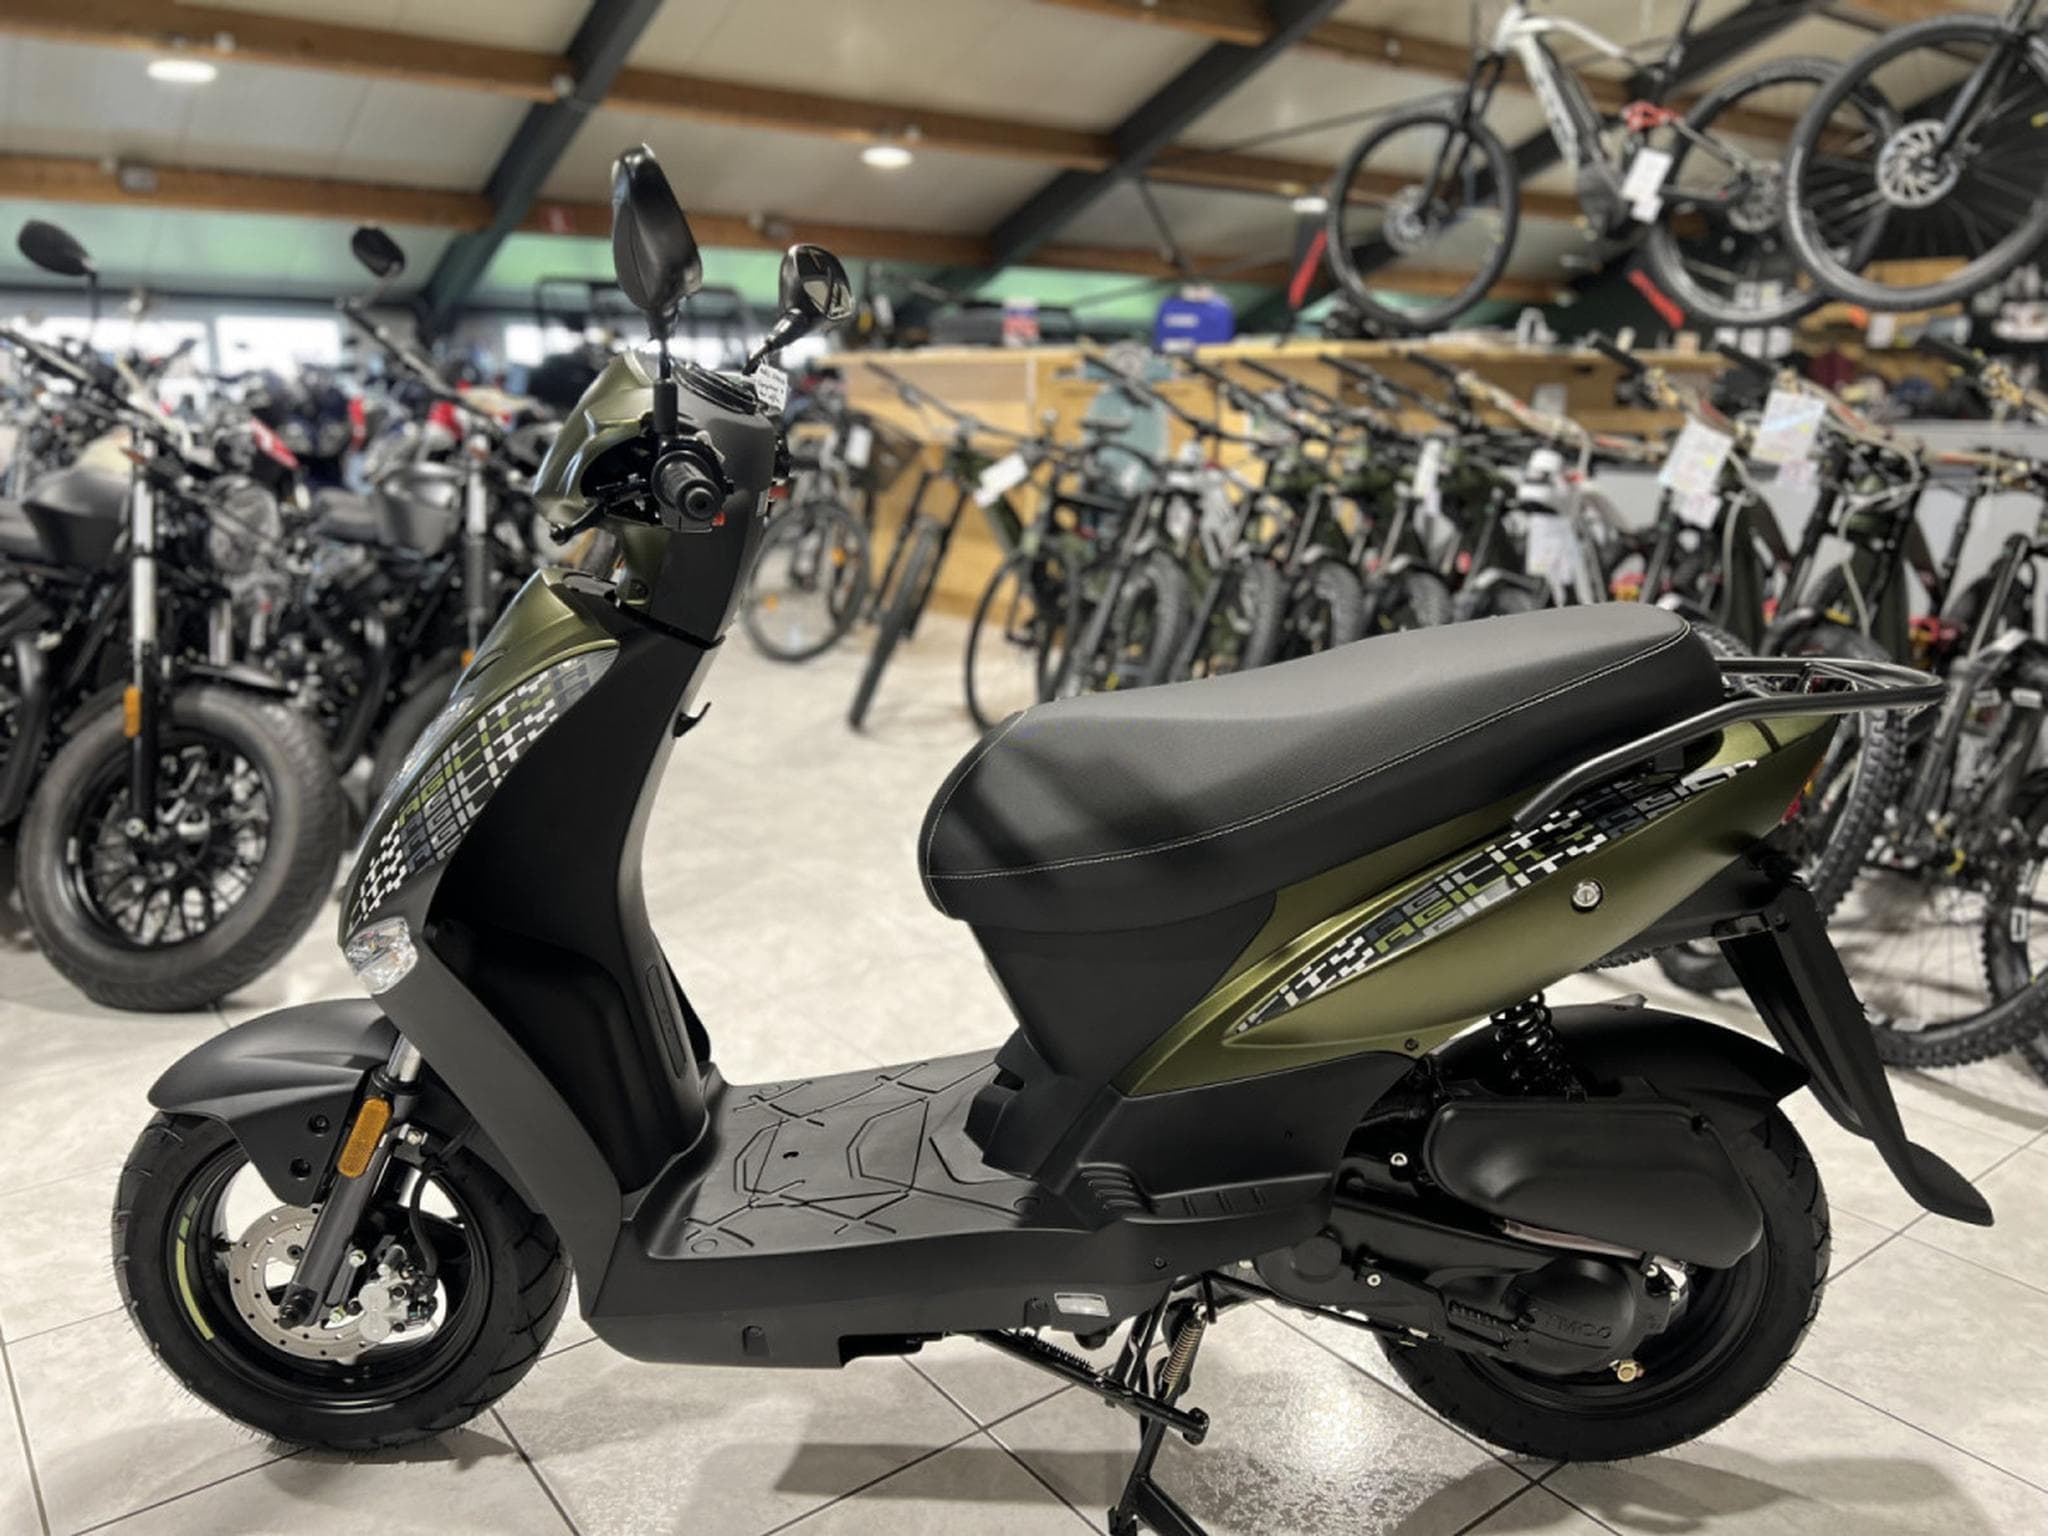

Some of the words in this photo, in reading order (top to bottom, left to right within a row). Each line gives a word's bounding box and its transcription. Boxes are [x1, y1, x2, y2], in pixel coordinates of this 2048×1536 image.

[399, 684, 552, 827] AGILITY
[400, 699, 556, 843] AGILITY
[402, 671, 549, 812] GILITY
[1365, 809, 1582, 941] AGILITY
[1374, 824, 1595, 954] AGILITY
[1403, 833, 1608, 947] GILITY
